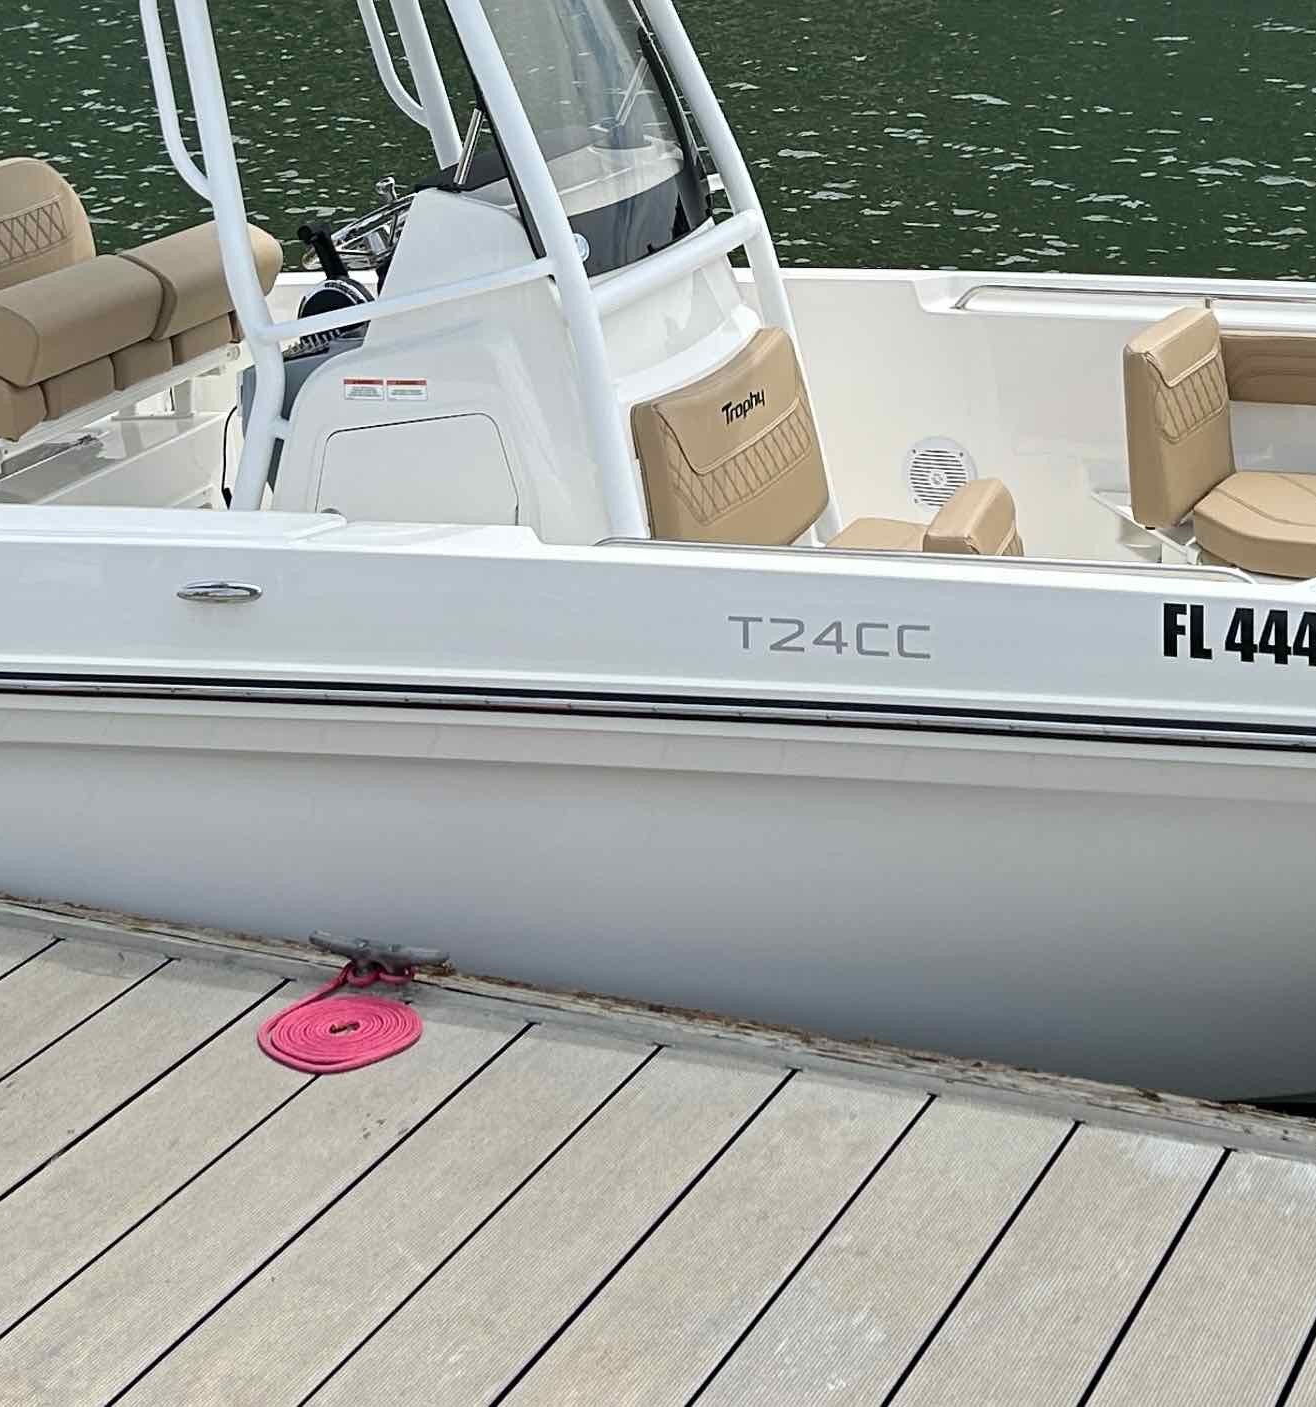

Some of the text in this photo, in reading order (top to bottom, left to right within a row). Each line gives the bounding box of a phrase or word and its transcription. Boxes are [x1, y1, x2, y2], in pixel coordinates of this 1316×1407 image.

[721, 388, 766, 425] Trophy
[727, 614, 932, 660] T24CC
[1162, 601, 1214, 661] FL
